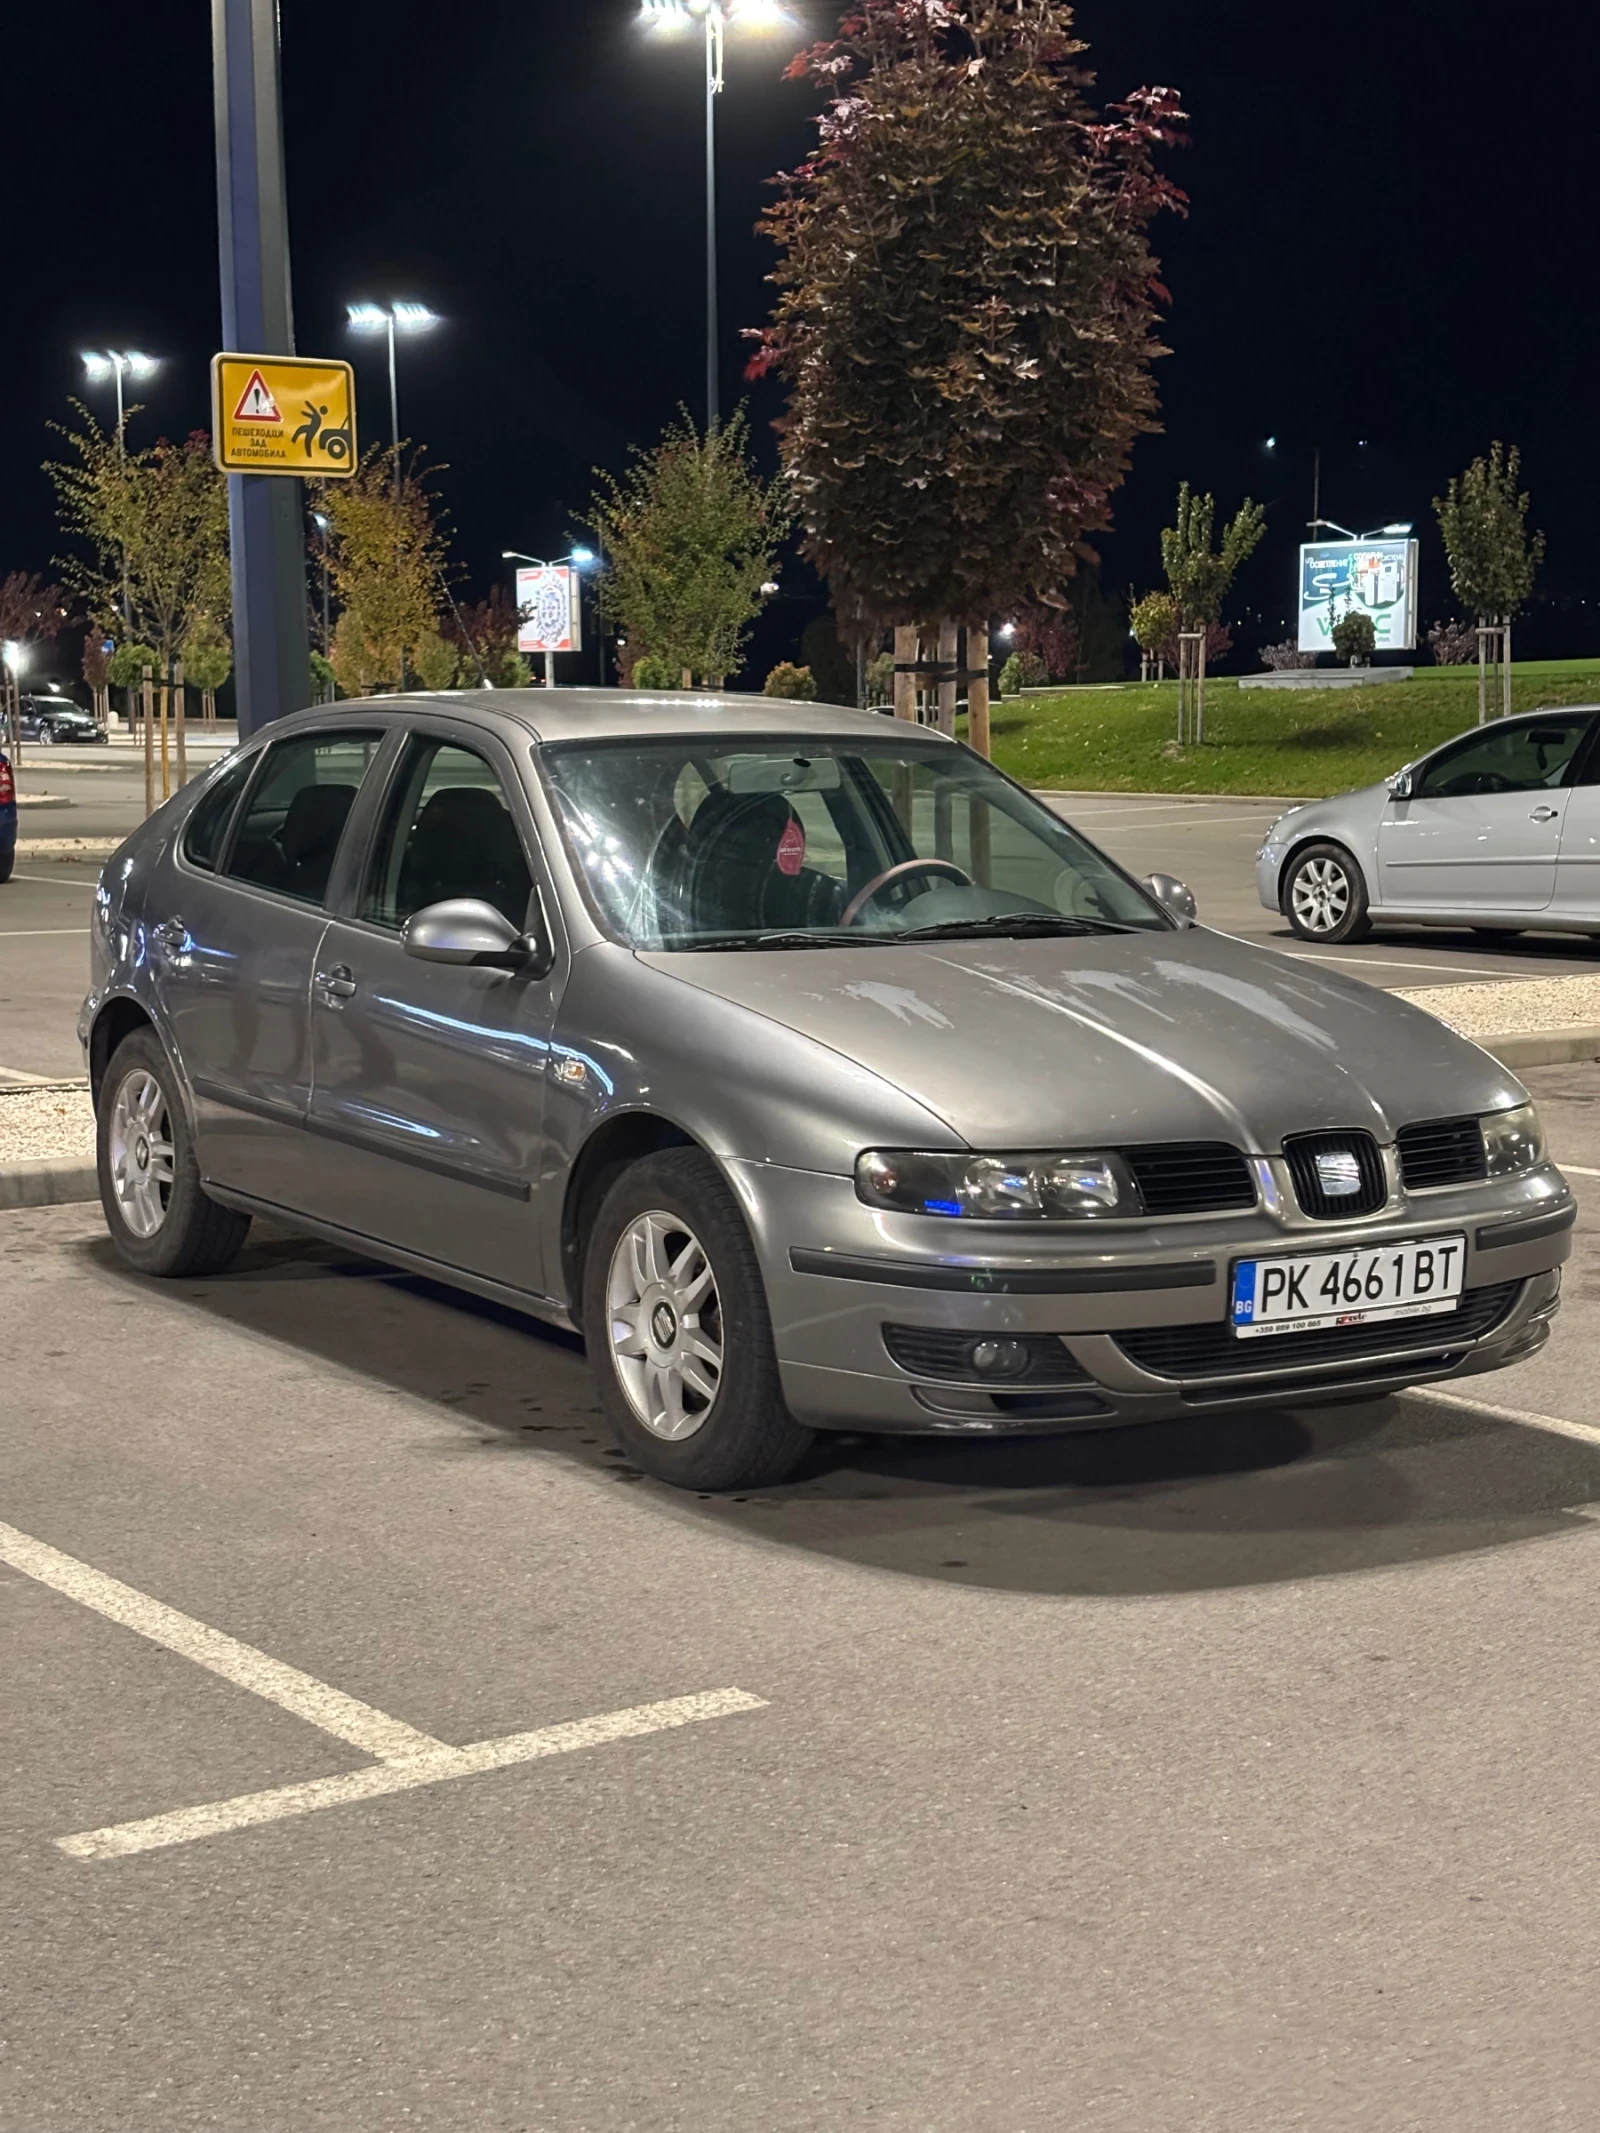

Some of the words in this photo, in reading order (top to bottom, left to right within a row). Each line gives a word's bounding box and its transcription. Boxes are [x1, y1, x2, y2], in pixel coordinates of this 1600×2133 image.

[232, 427, 283, 438] ПЕШЕХОДЦИ
[250, 438, 266, 448] ЗАД
[231, 448, 286, 458] АВТОМОБИЛА
[1262, 1264, 1311, 1313] PK
[1320, 1254, 1404, 1305] 4661
[1413, 1246, 1458, 1293] BT
[1235, 1300, 1253, 1315] BG
[1292, 1321, 1306, 1329] 100
